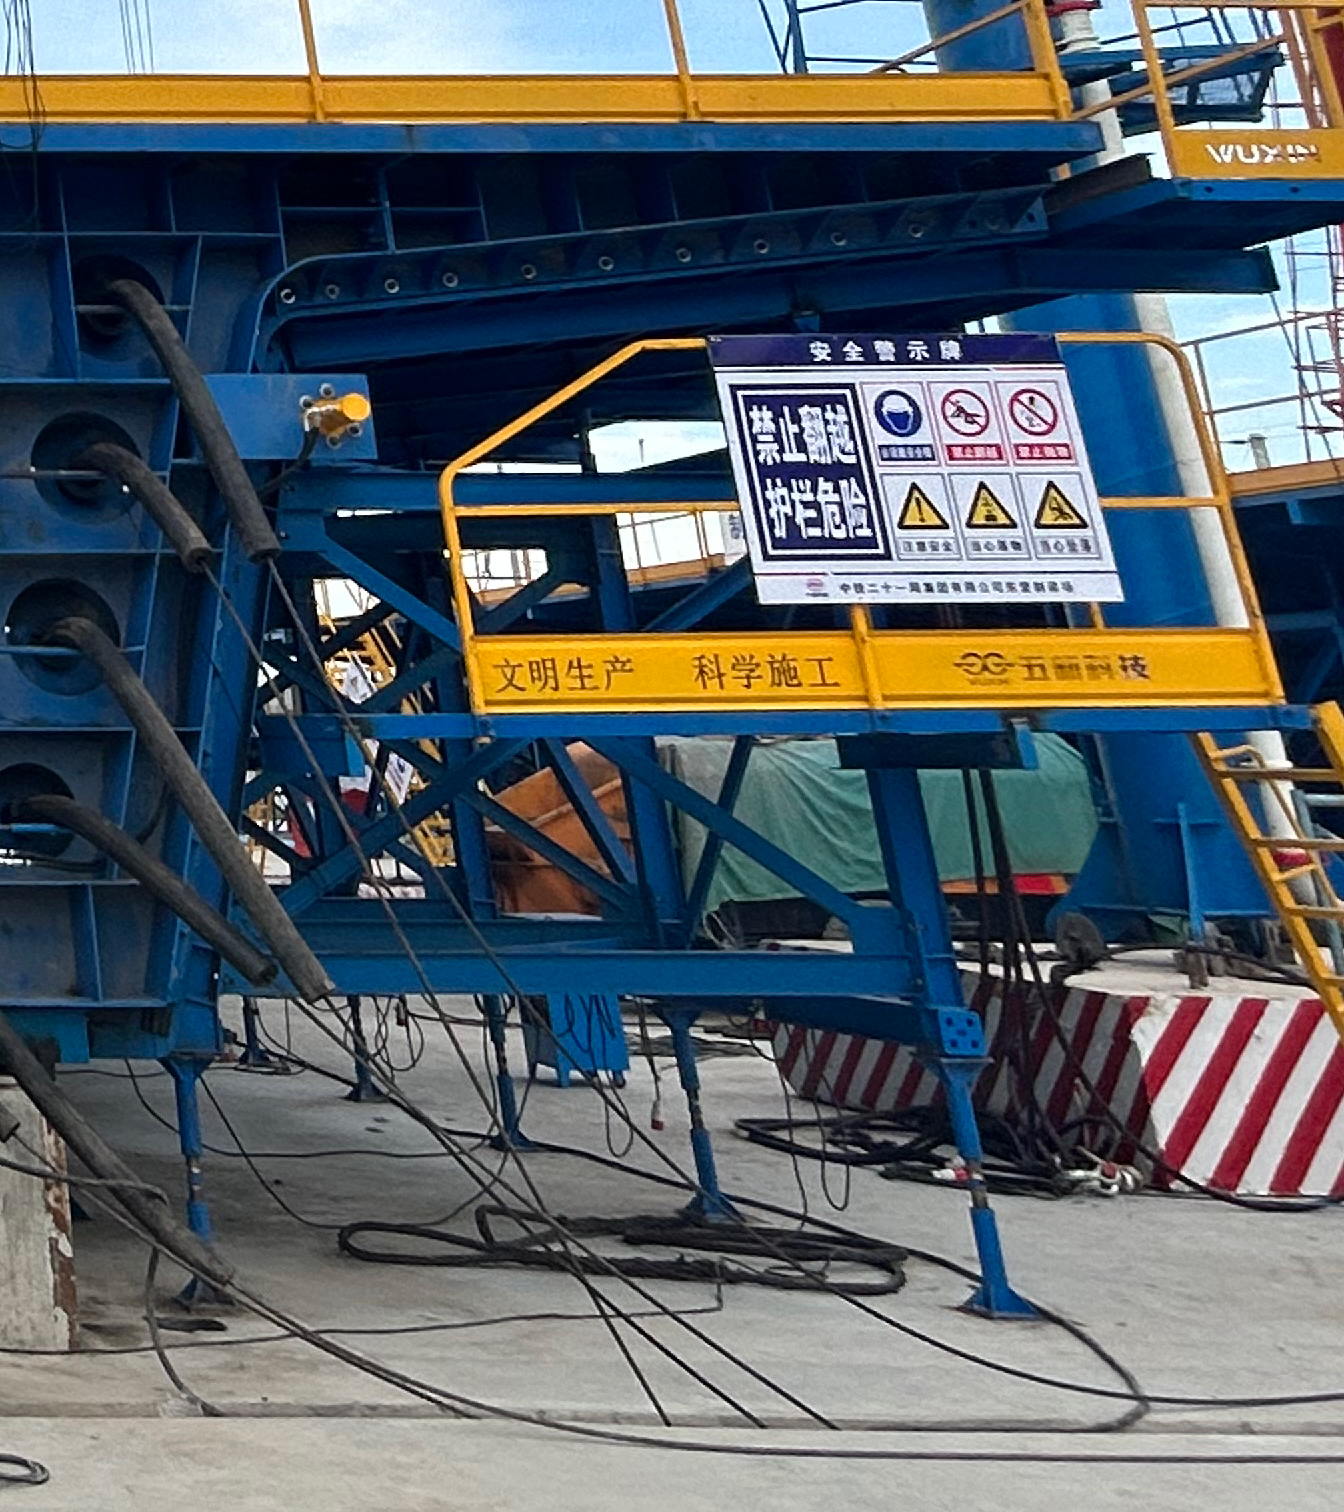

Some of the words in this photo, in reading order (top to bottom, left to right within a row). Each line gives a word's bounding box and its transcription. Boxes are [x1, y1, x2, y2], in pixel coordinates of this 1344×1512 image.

[1204, 143, 1318, 164] WUXIN
[809, 339, 962, 362] 安全警示牌
[749, 404, 858, 466] 禁止翻越
[765, 476, 873, 539] 护栏危险
[493, 655, 634, 694] 文明生产
[692, 652, 841, 690] 科学施工
